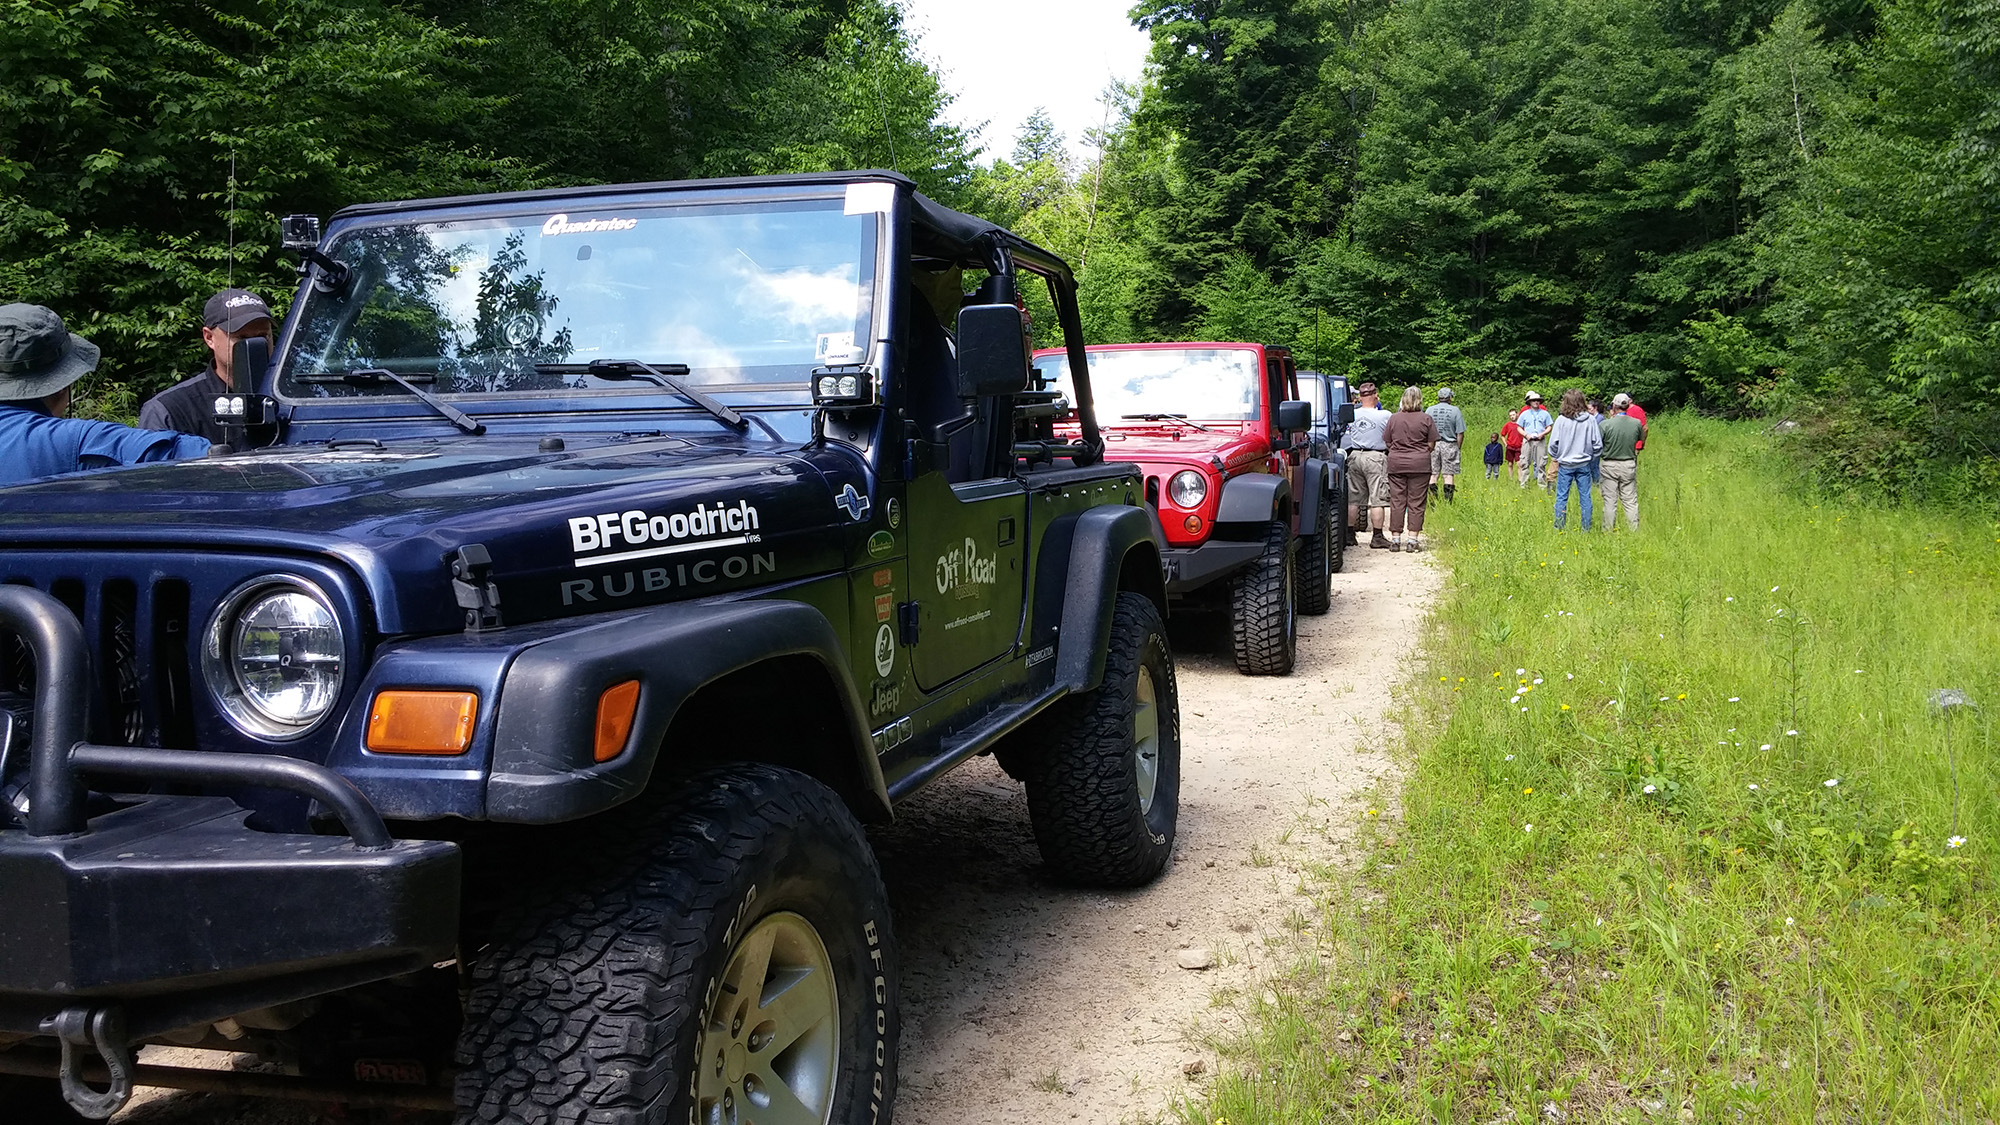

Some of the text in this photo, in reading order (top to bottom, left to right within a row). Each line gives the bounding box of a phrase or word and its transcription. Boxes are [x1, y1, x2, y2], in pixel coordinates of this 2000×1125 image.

[542, 213, 638, 236] Quadratec
[1228, 452, 1256, 467] RUBICON
[568, 500, 759, 552] BFGoodrich
[744, 532, 761, 544] Tires
[561, 552, 776, 606] RUBICON
[936, 548, 960, 595] Off
[964, 537, 997, 584] Road
[871, 687, 900, 716] Jeep
